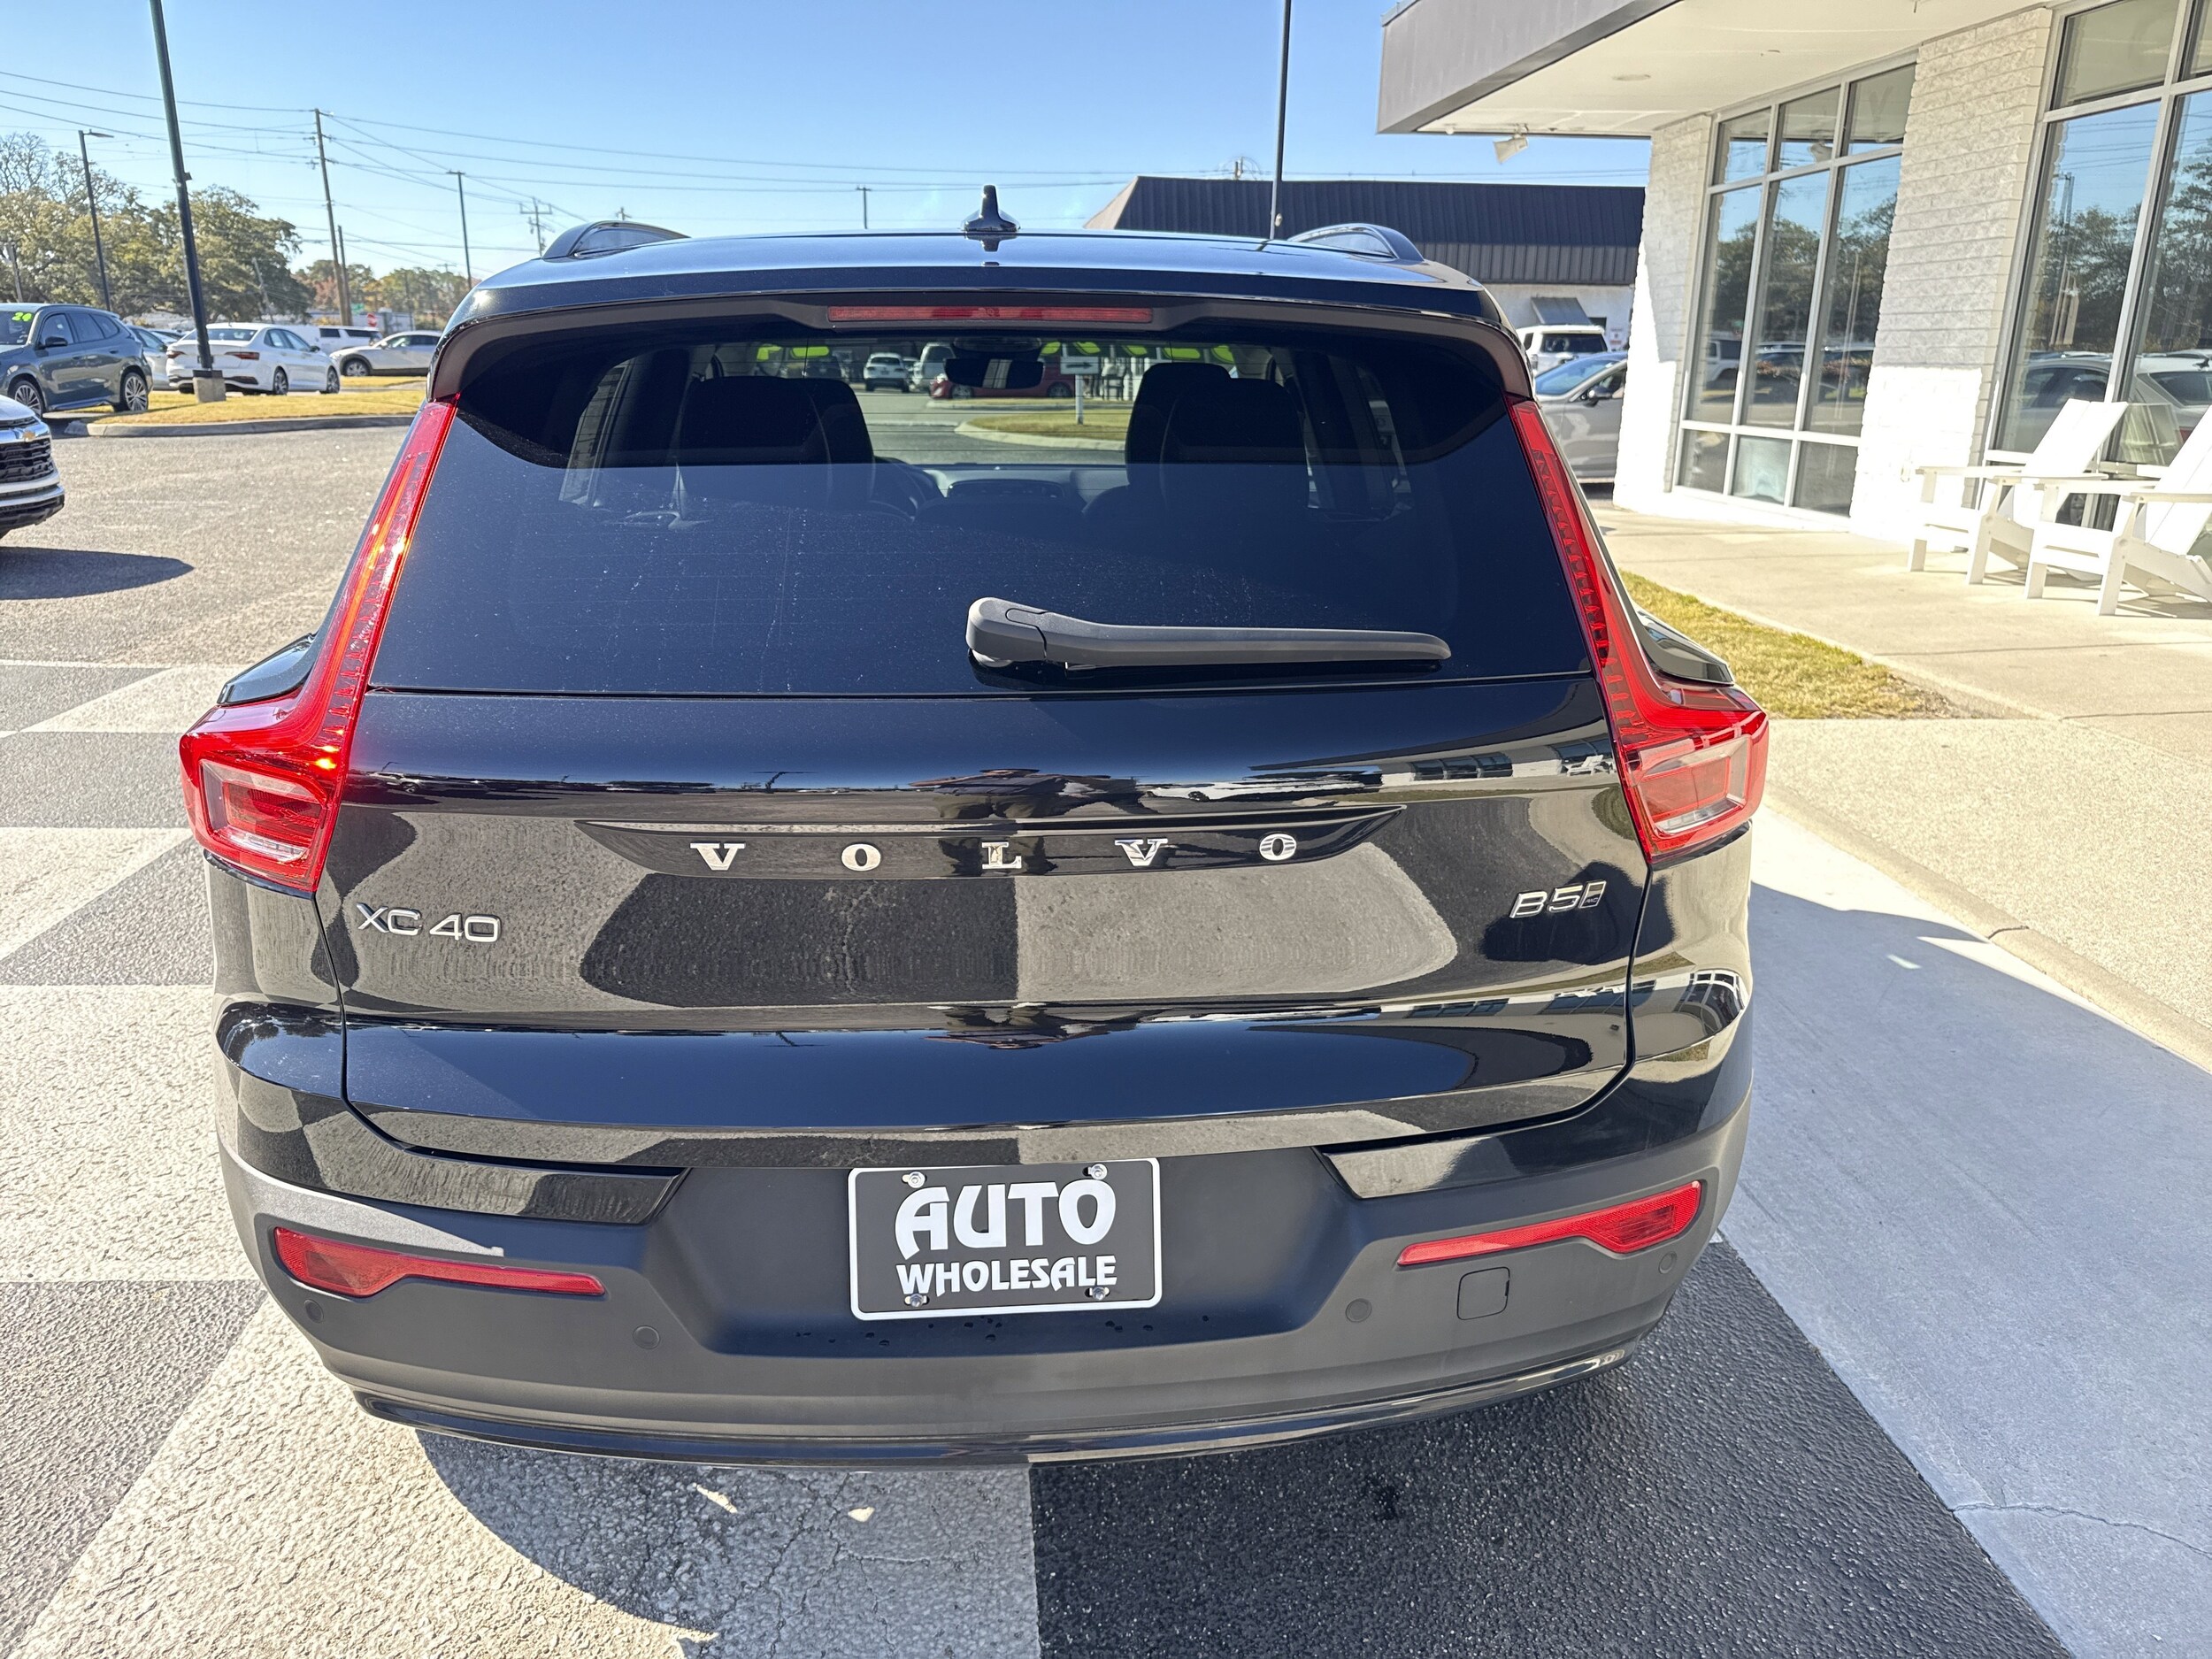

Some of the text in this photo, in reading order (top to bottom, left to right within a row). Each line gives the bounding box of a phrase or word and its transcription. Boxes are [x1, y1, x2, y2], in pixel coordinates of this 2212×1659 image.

[690, 833, 1298, 872] VOLVO
[1509, 885, 1583, 918] B5
[895, 1179, 1117, 1260] AUTO
[895, 1255, 1118, 1297] WHOLESALE
